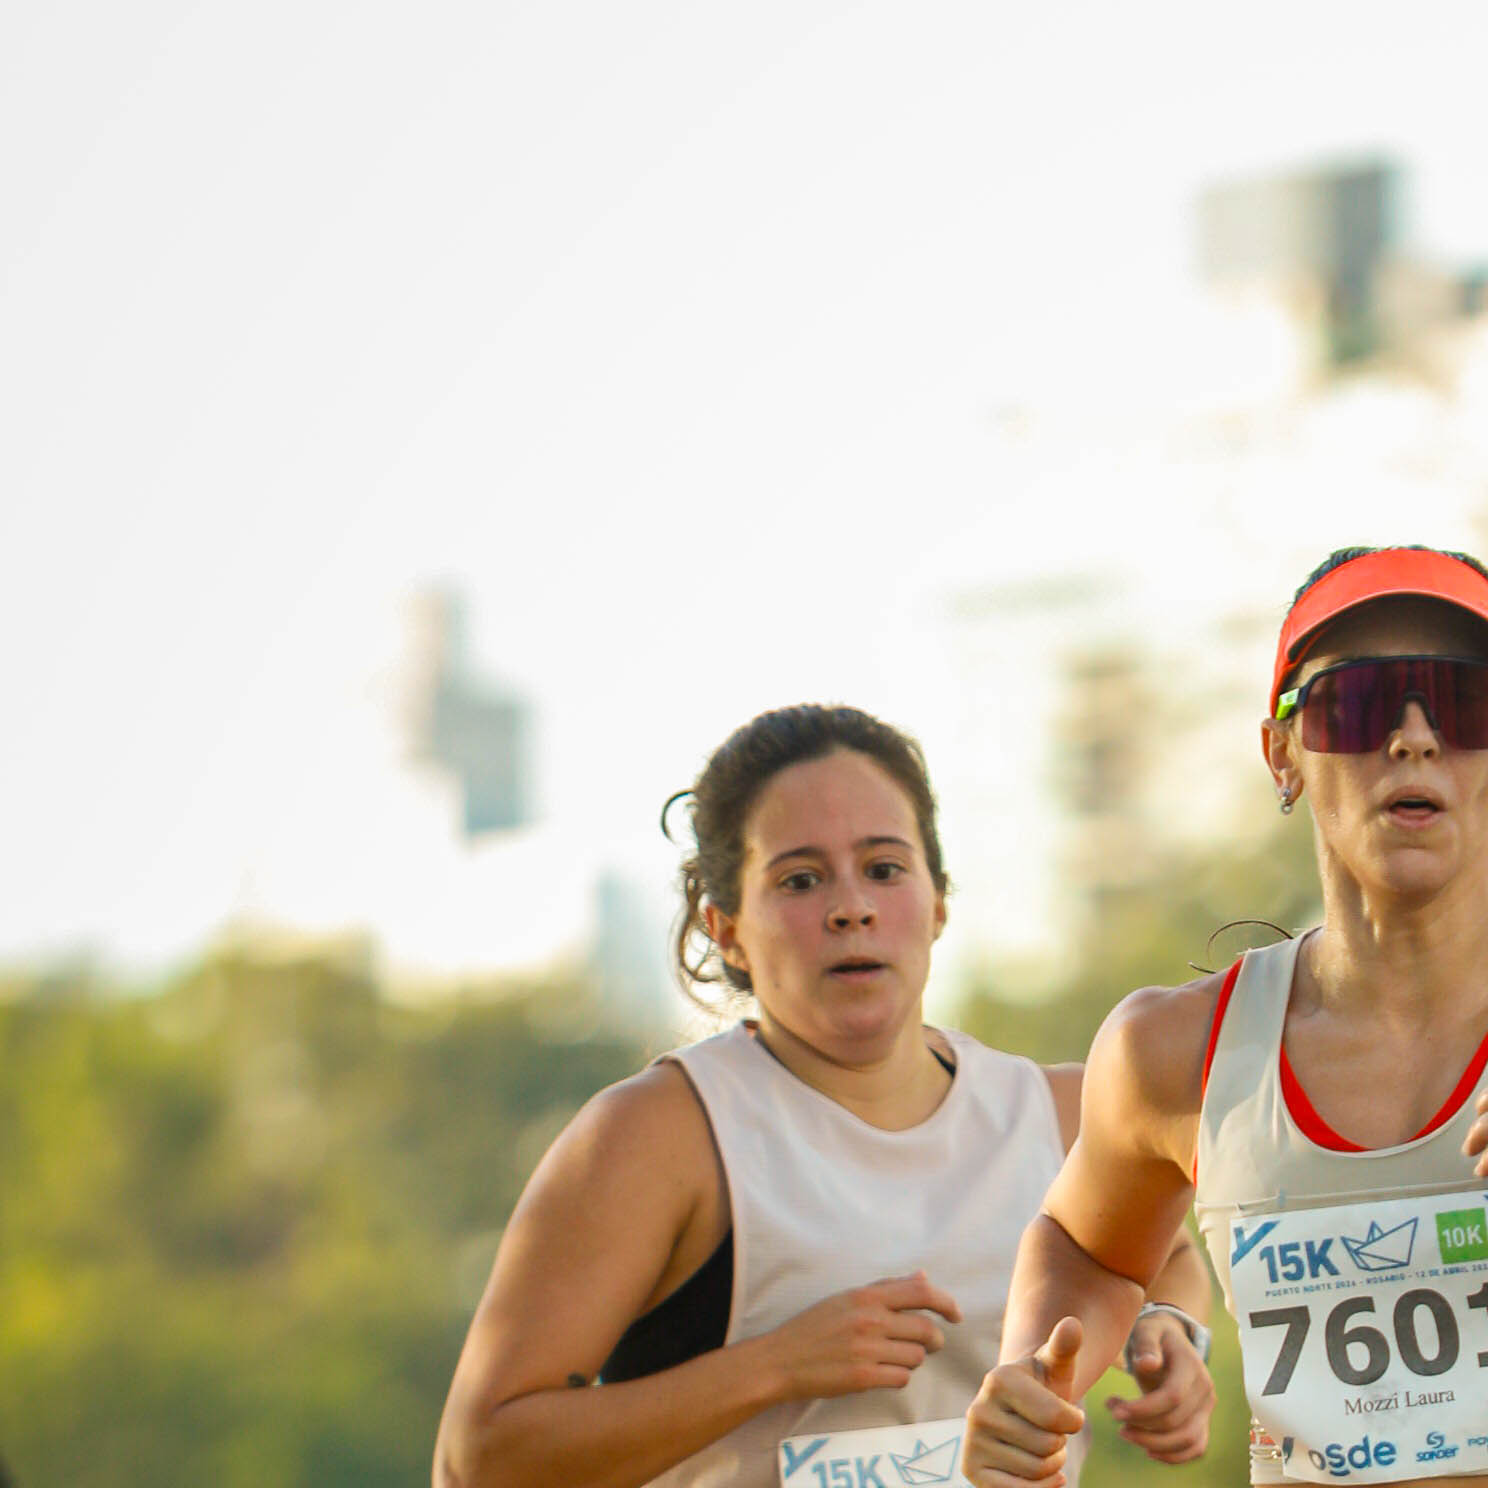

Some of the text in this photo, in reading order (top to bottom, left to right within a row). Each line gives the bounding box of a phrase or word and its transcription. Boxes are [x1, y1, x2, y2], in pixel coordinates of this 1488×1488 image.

[1441, 1223, 1484, 1249] 10K
[1260, 1238, 1340, 1283] 15K
[1303, 1282, 1332, 1293] NORTE
[1344, 1390, 1456, 1415] Mozzi Laura
[1308, 1435, 1397, 1473] osde
